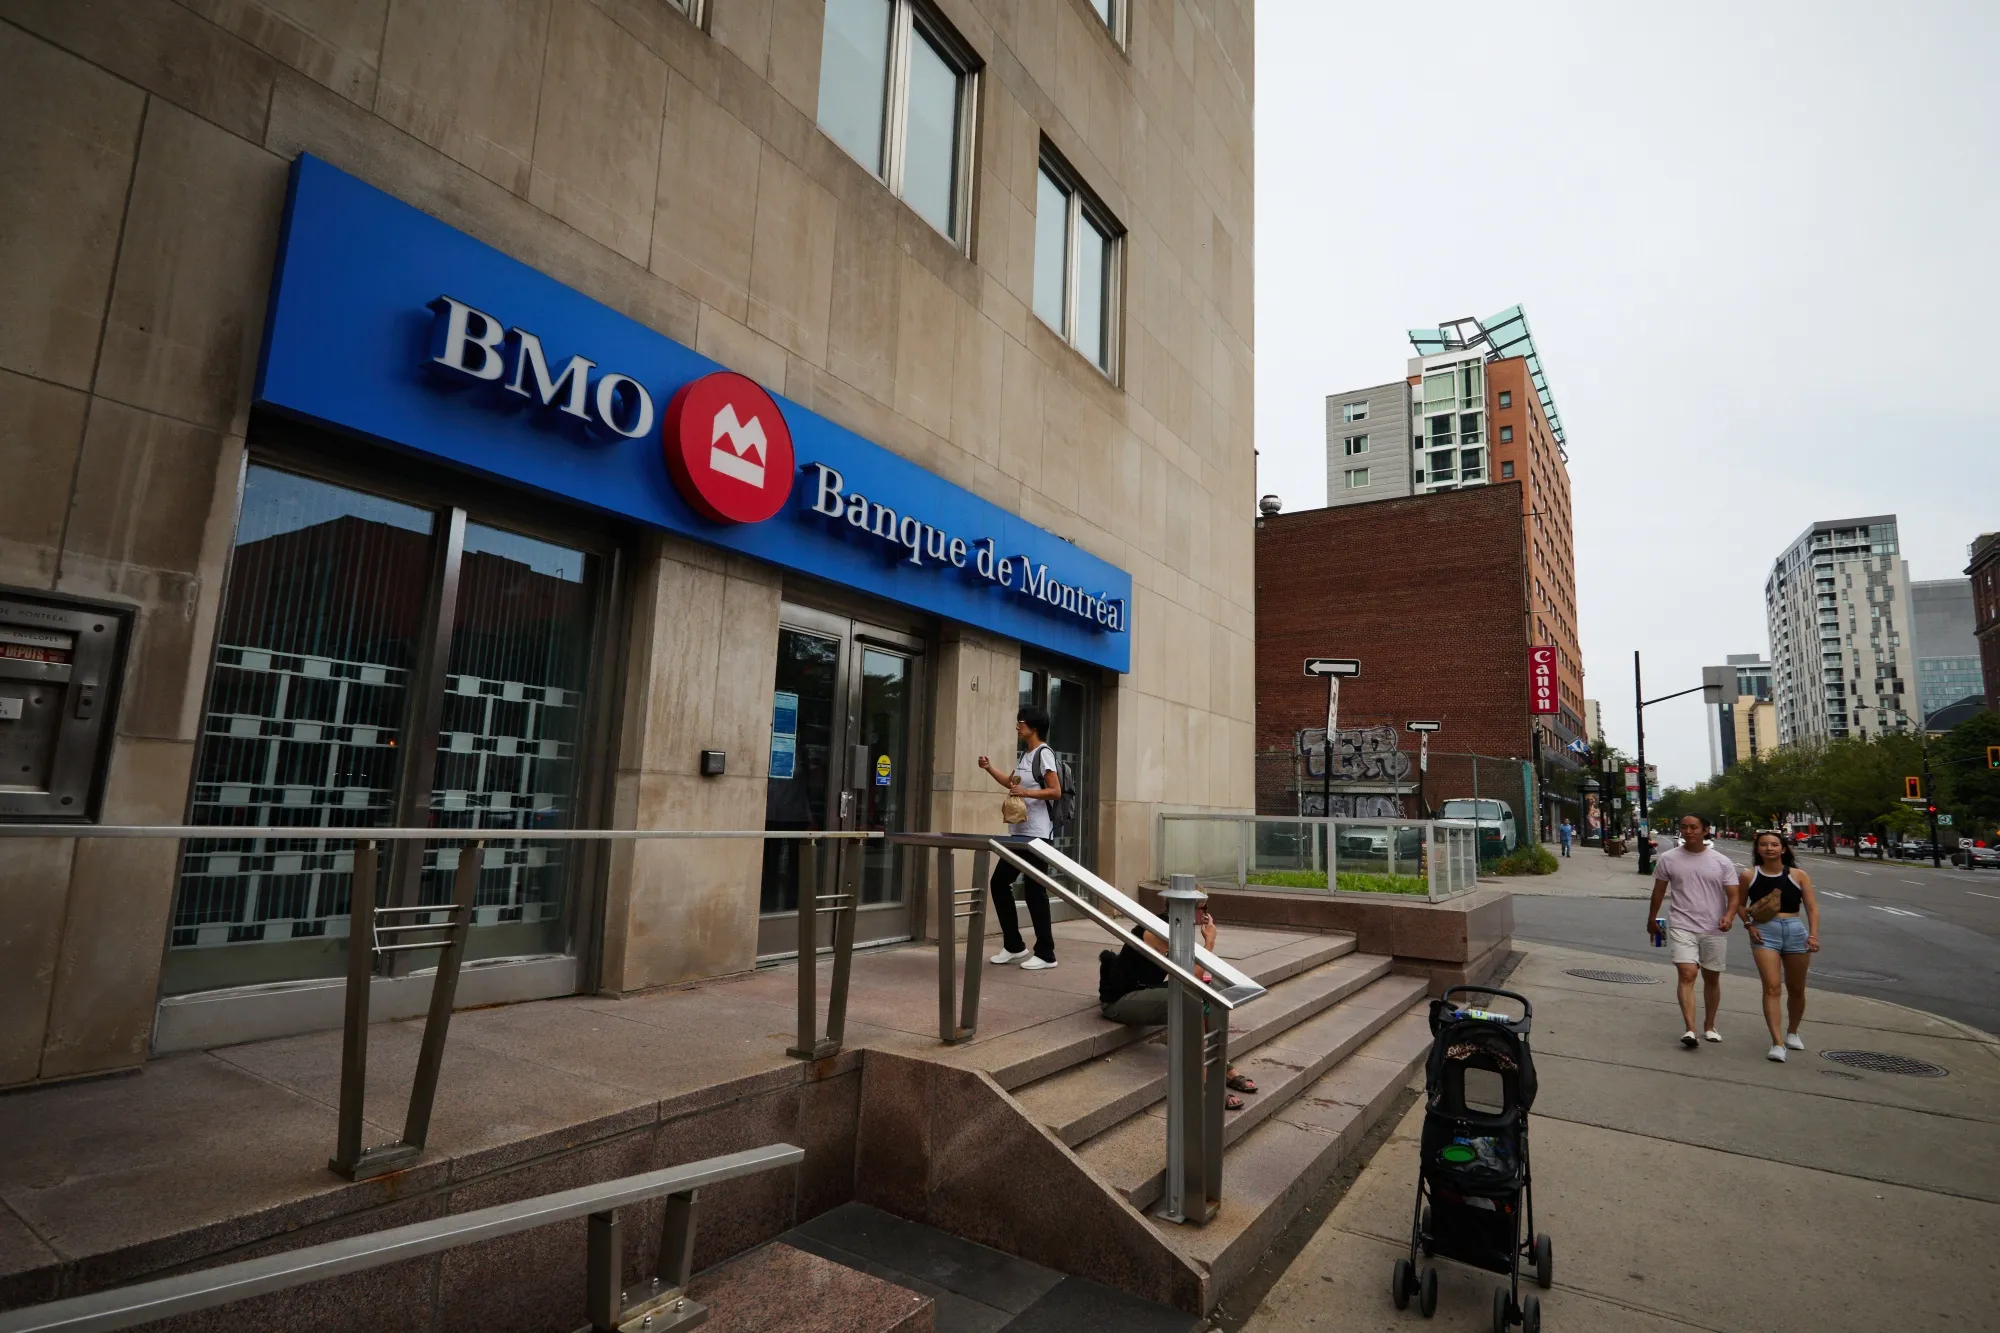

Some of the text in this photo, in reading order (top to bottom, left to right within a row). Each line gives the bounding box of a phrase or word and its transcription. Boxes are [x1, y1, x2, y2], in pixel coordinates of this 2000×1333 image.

[433, 295, 654, 439] BMO
[811, 461, 1126, 633] Banque de Montréal
[1534, 650, 1551, 710] Canon
